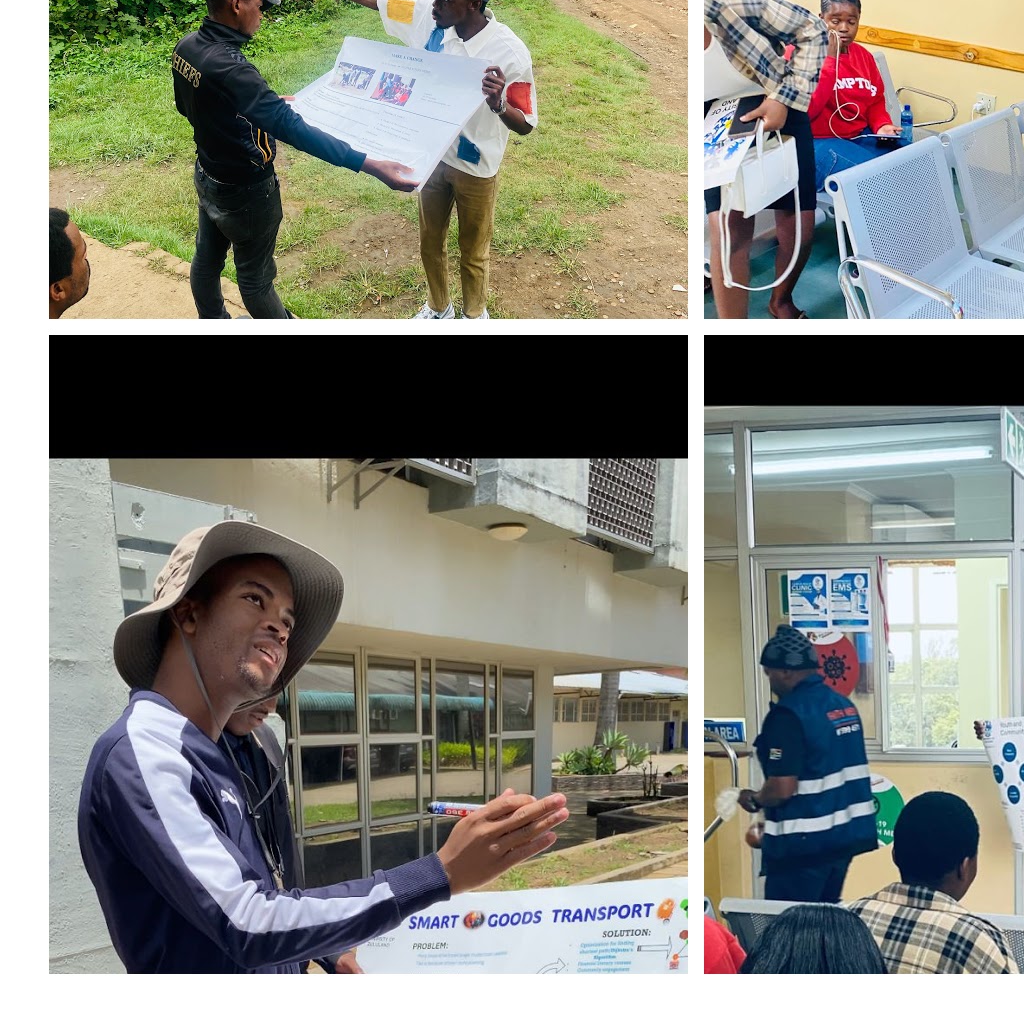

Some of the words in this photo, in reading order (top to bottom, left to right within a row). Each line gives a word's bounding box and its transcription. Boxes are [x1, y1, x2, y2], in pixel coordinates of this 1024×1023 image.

[408, 914, 460, 930] SMART
[487, 911, 542, 927] GOODS
[552, 903, 654, 923] TRANSPORT
[602, 929, 652, 938] SOLUTION:
[412, 941, 449, 950] PROBLEM:
